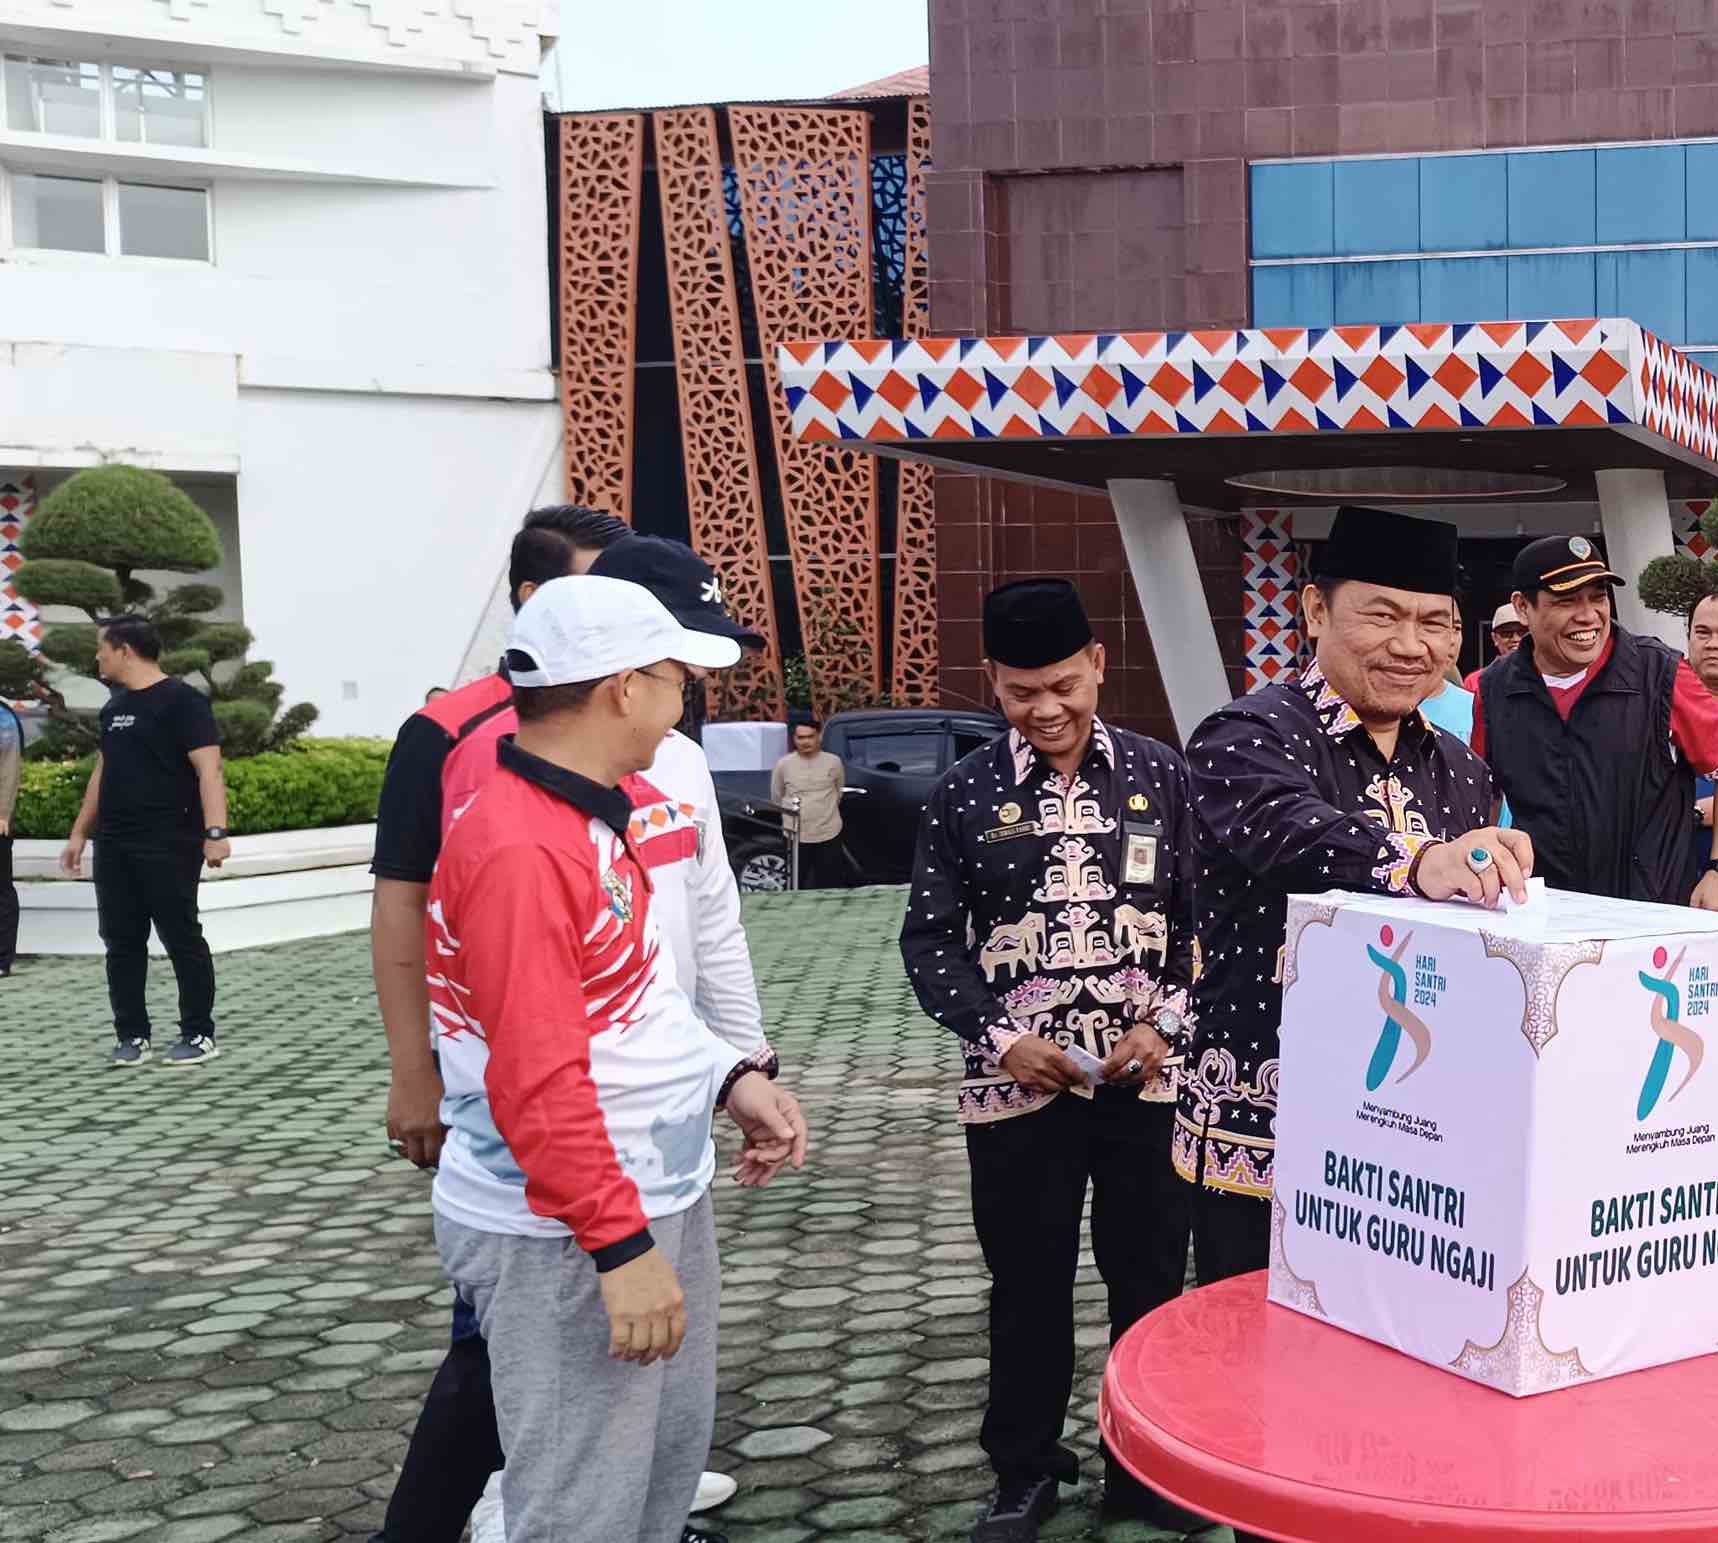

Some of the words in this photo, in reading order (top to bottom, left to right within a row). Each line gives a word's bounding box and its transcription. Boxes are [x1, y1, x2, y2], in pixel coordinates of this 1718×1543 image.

[1416, 954, 1436, 972] HARI
[1415, 971, 1446, 992] SANTRI
[1689, 966, 1709, 981] HARI
[1414, 989, 1437, 1008] 2024
[1688, 982, 1718, 999] SANTRI
[1687, 1000, 1709, 1017] 2024
[1363, 1100, 1412, 1125] Menyambung
[1414, 1115, 1437, 1132] Juang
[1399, 1121, 1418, 1136] Masa
[1419, 1127, 1443, 1142] Depan
[1633, 1127, 1685, 1142] Menyambung
[1686, 1124, 1709, 1135] Juang
[1671, 1137, 1691, 1148] Masa
[1692, 1134, 1715, 1145] Depan
[1324, 1150, 1383, 1202] BAKTI
[1388, 1169, 1465, 1229] SANTRI
[1590, 1190, 1655, 1238] BAKTI
[1295, 1189, 1362, 1245] UNTUK
[1367, 1214, 1425, 1267] GURU
[1430, 1234, 1495, 1292] NGAJI
[1555, 1245, 1632, 1296] UNTUK
[1637, 1232, 1697, 1279] GURU
